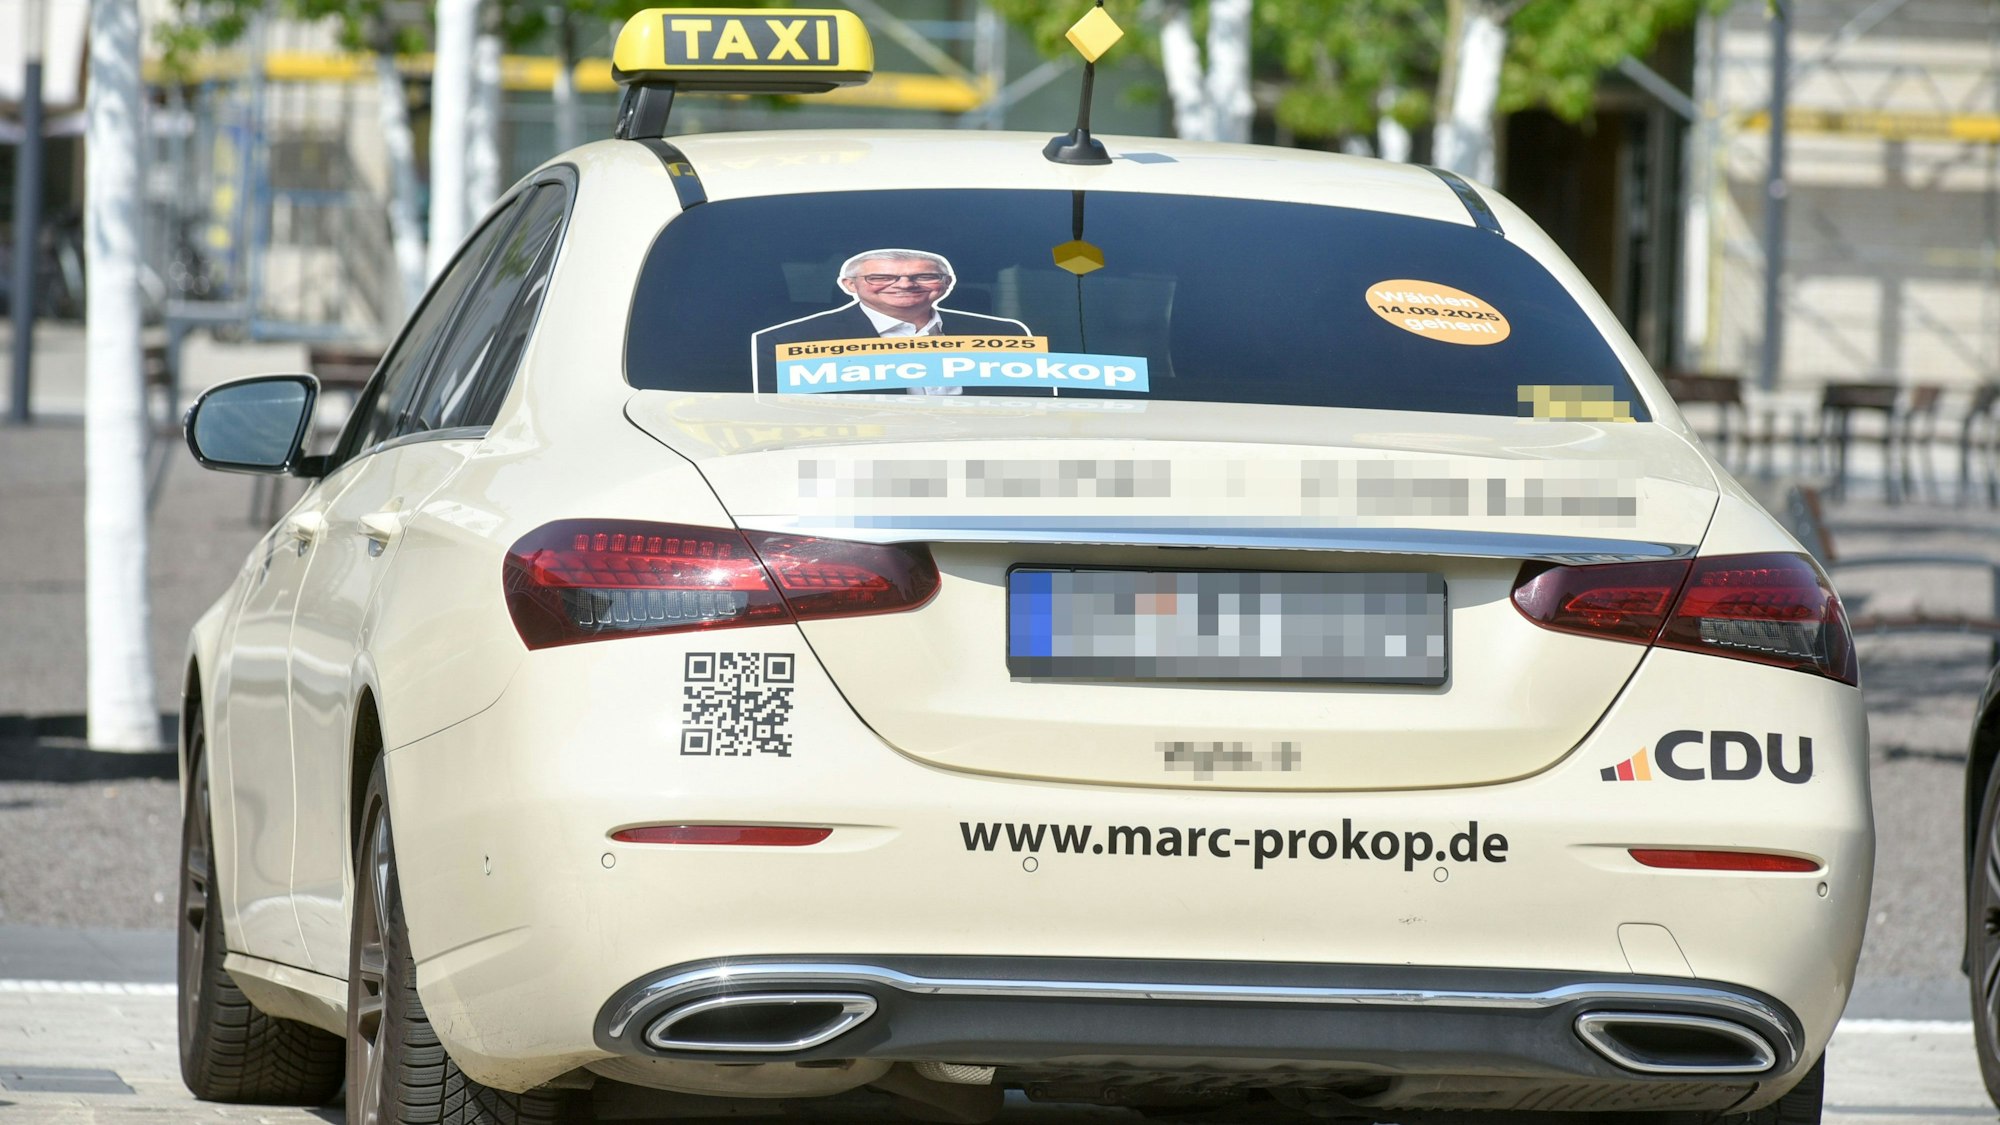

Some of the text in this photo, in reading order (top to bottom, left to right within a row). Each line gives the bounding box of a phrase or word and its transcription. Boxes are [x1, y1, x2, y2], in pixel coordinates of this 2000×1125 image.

[671, 19, 831, 60] TAXI
[1374, 290, 1479, 309] Wählen
[1377, 305, 1500, 322] 14.09.2025
[1404, 317, 1498, 334] gehen!
[788, 338, 1036, 356] Bürgermeister 2025
[788, 357, 1137, 387] Marc Prokop
[1653, 730, 1813, 784] CDU
[960, 818, 1508, 870] www.marc-prokop.de
